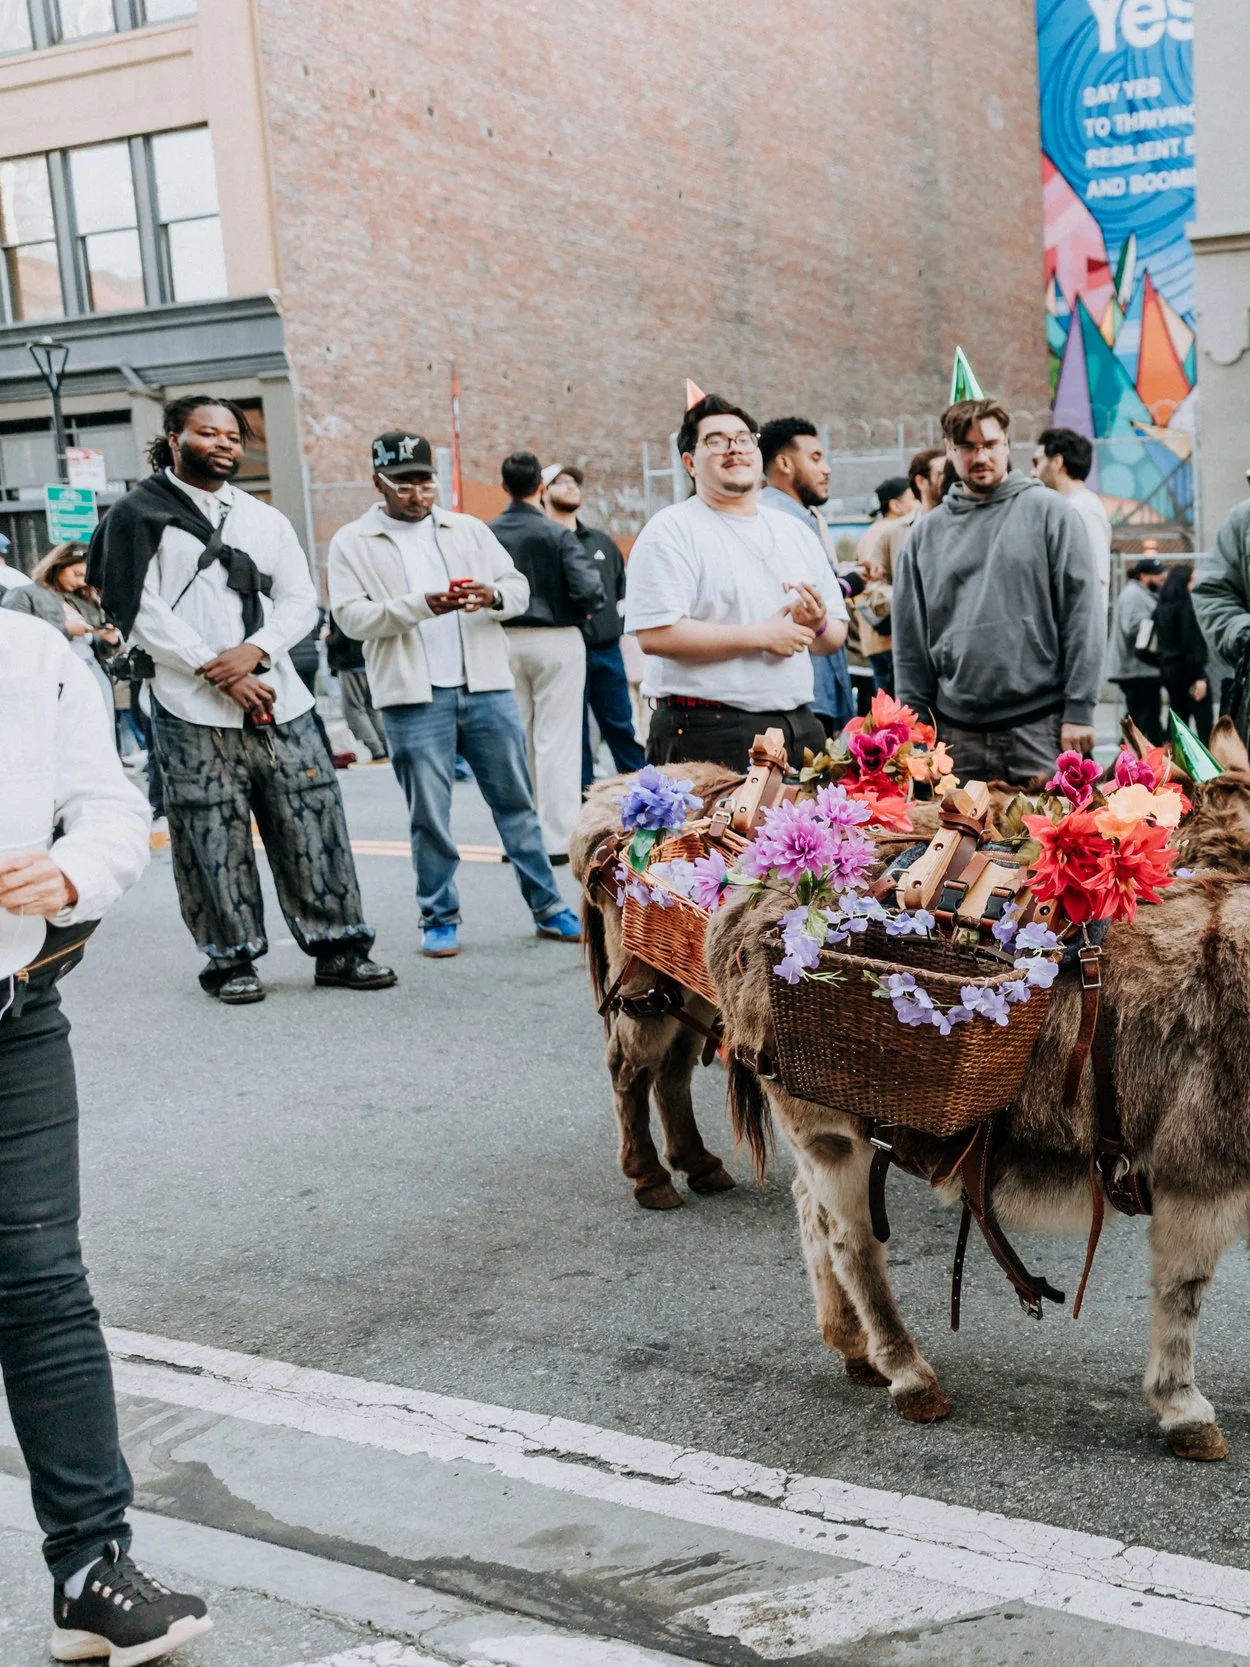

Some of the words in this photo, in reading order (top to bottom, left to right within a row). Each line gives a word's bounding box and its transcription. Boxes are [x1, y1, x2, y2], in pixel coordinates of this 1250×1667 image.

[1083, 82, 1120, 107] SAY
[1122, 77, 1161, 99] YES
[1083, 117, 1111, 139] TO
[1085, 138, 1181, 169] RESILIENT
[1086, 177, 1126, 199] AND
